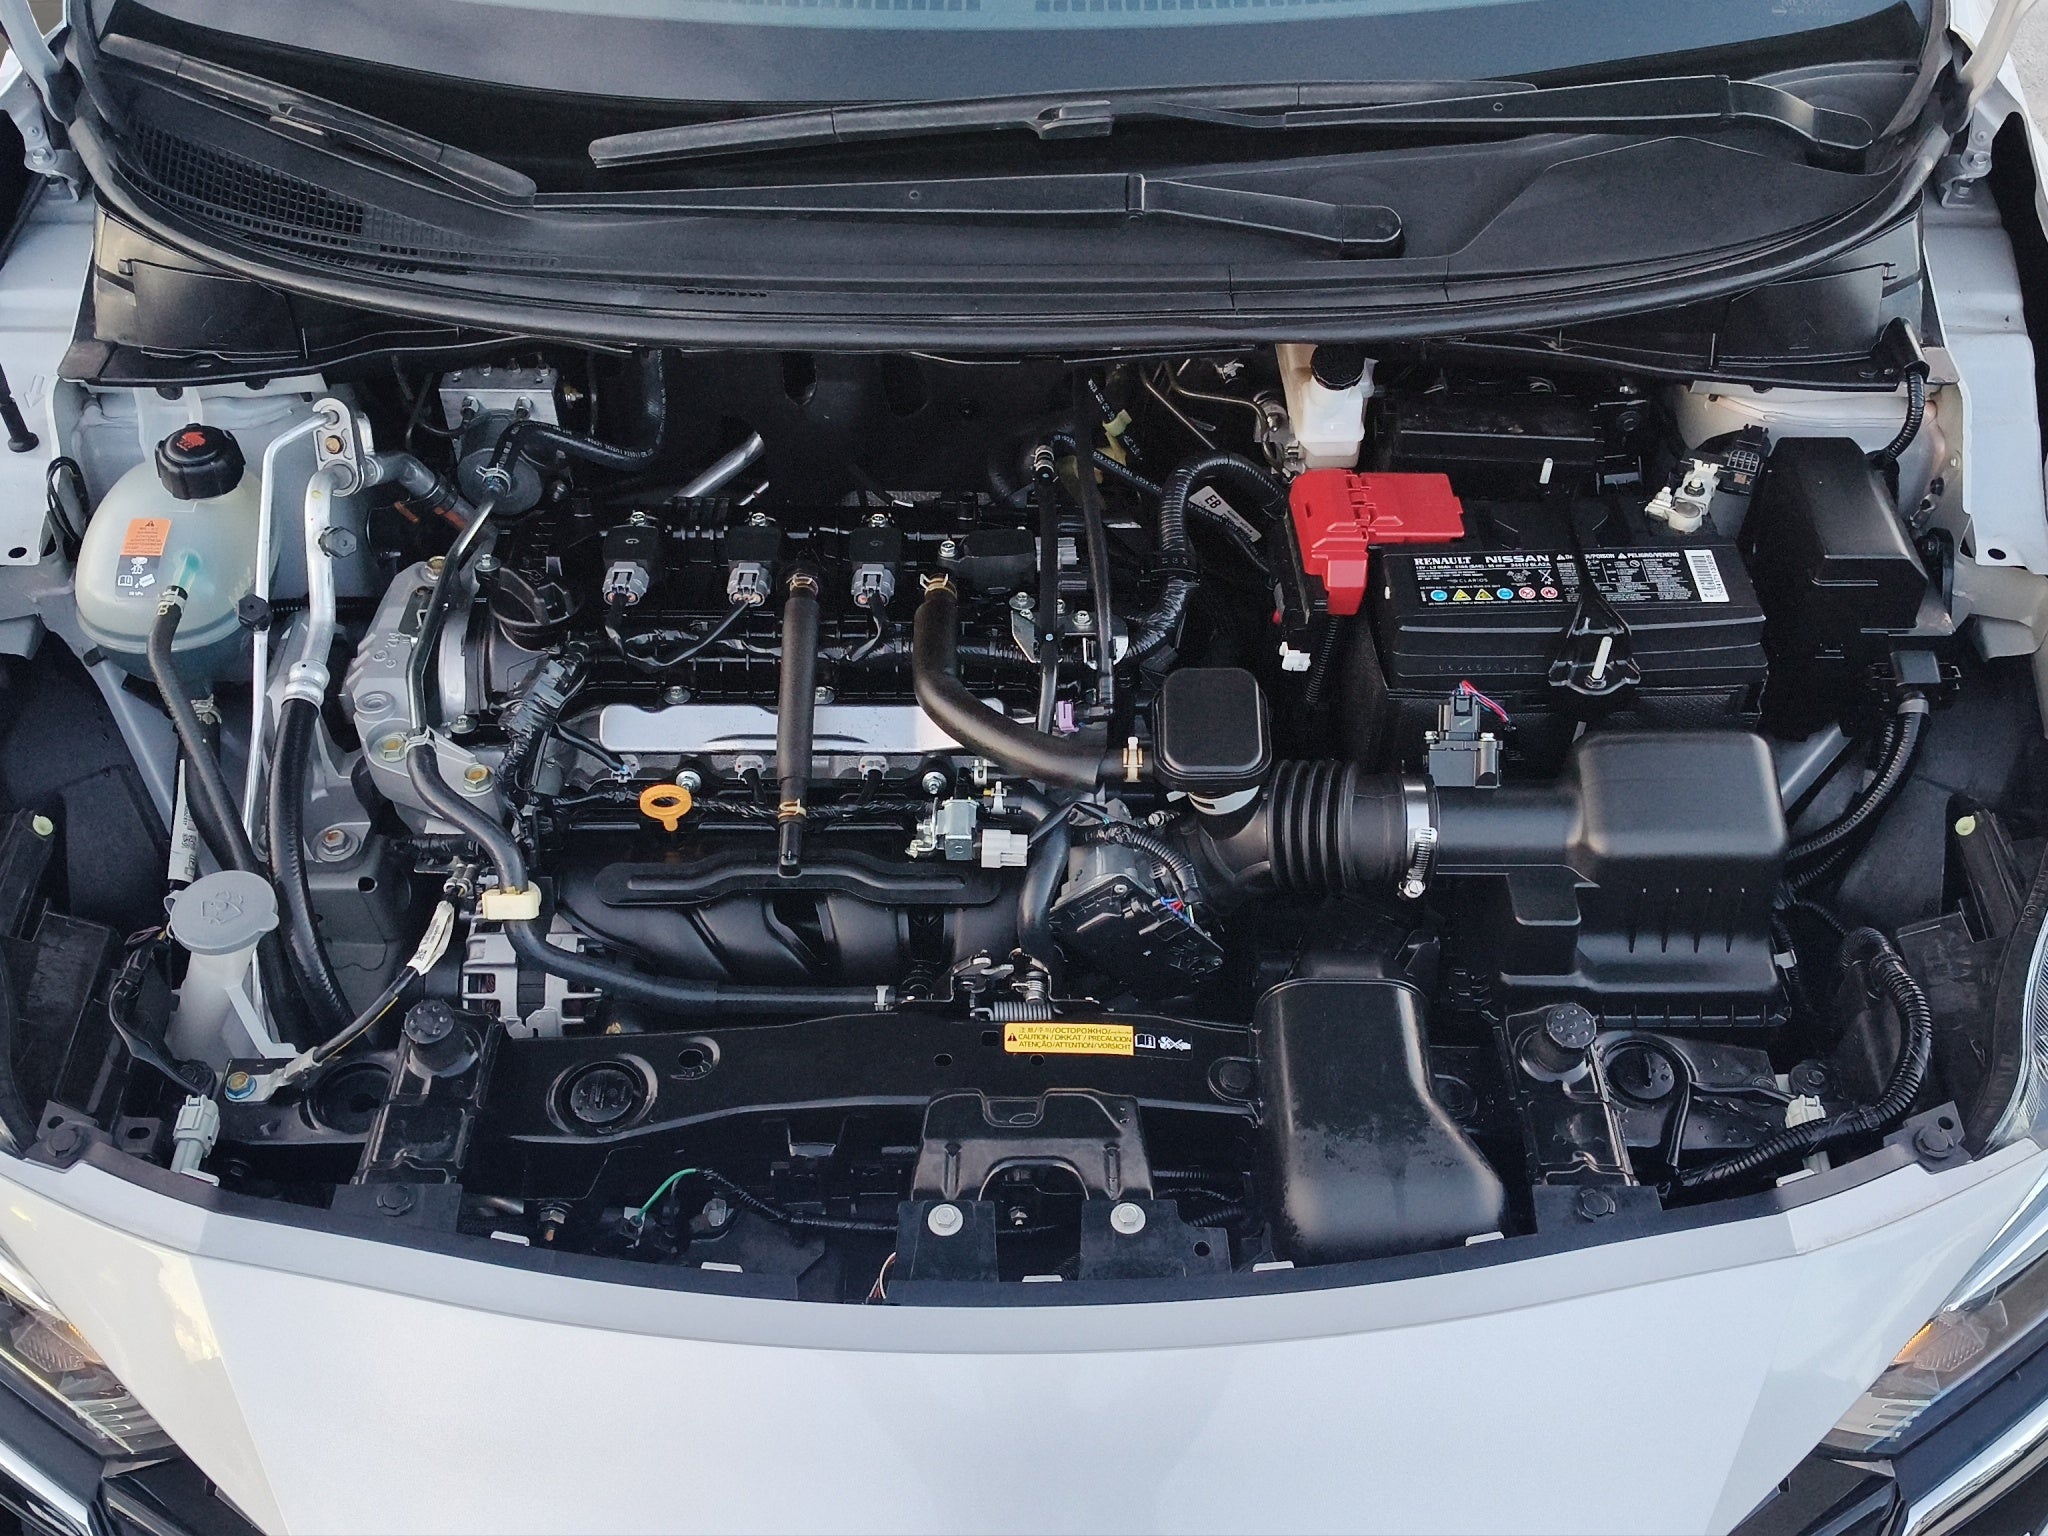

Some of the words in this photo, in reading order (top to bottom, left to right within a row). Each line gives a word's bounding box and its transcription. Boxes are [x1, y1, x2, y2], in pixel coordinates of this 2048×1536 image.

[1204, 494, 1221, 509] EB
[1414, 556, 1471, 565] RENAULT
[1485, 554, 1550, 563] NISSAN
